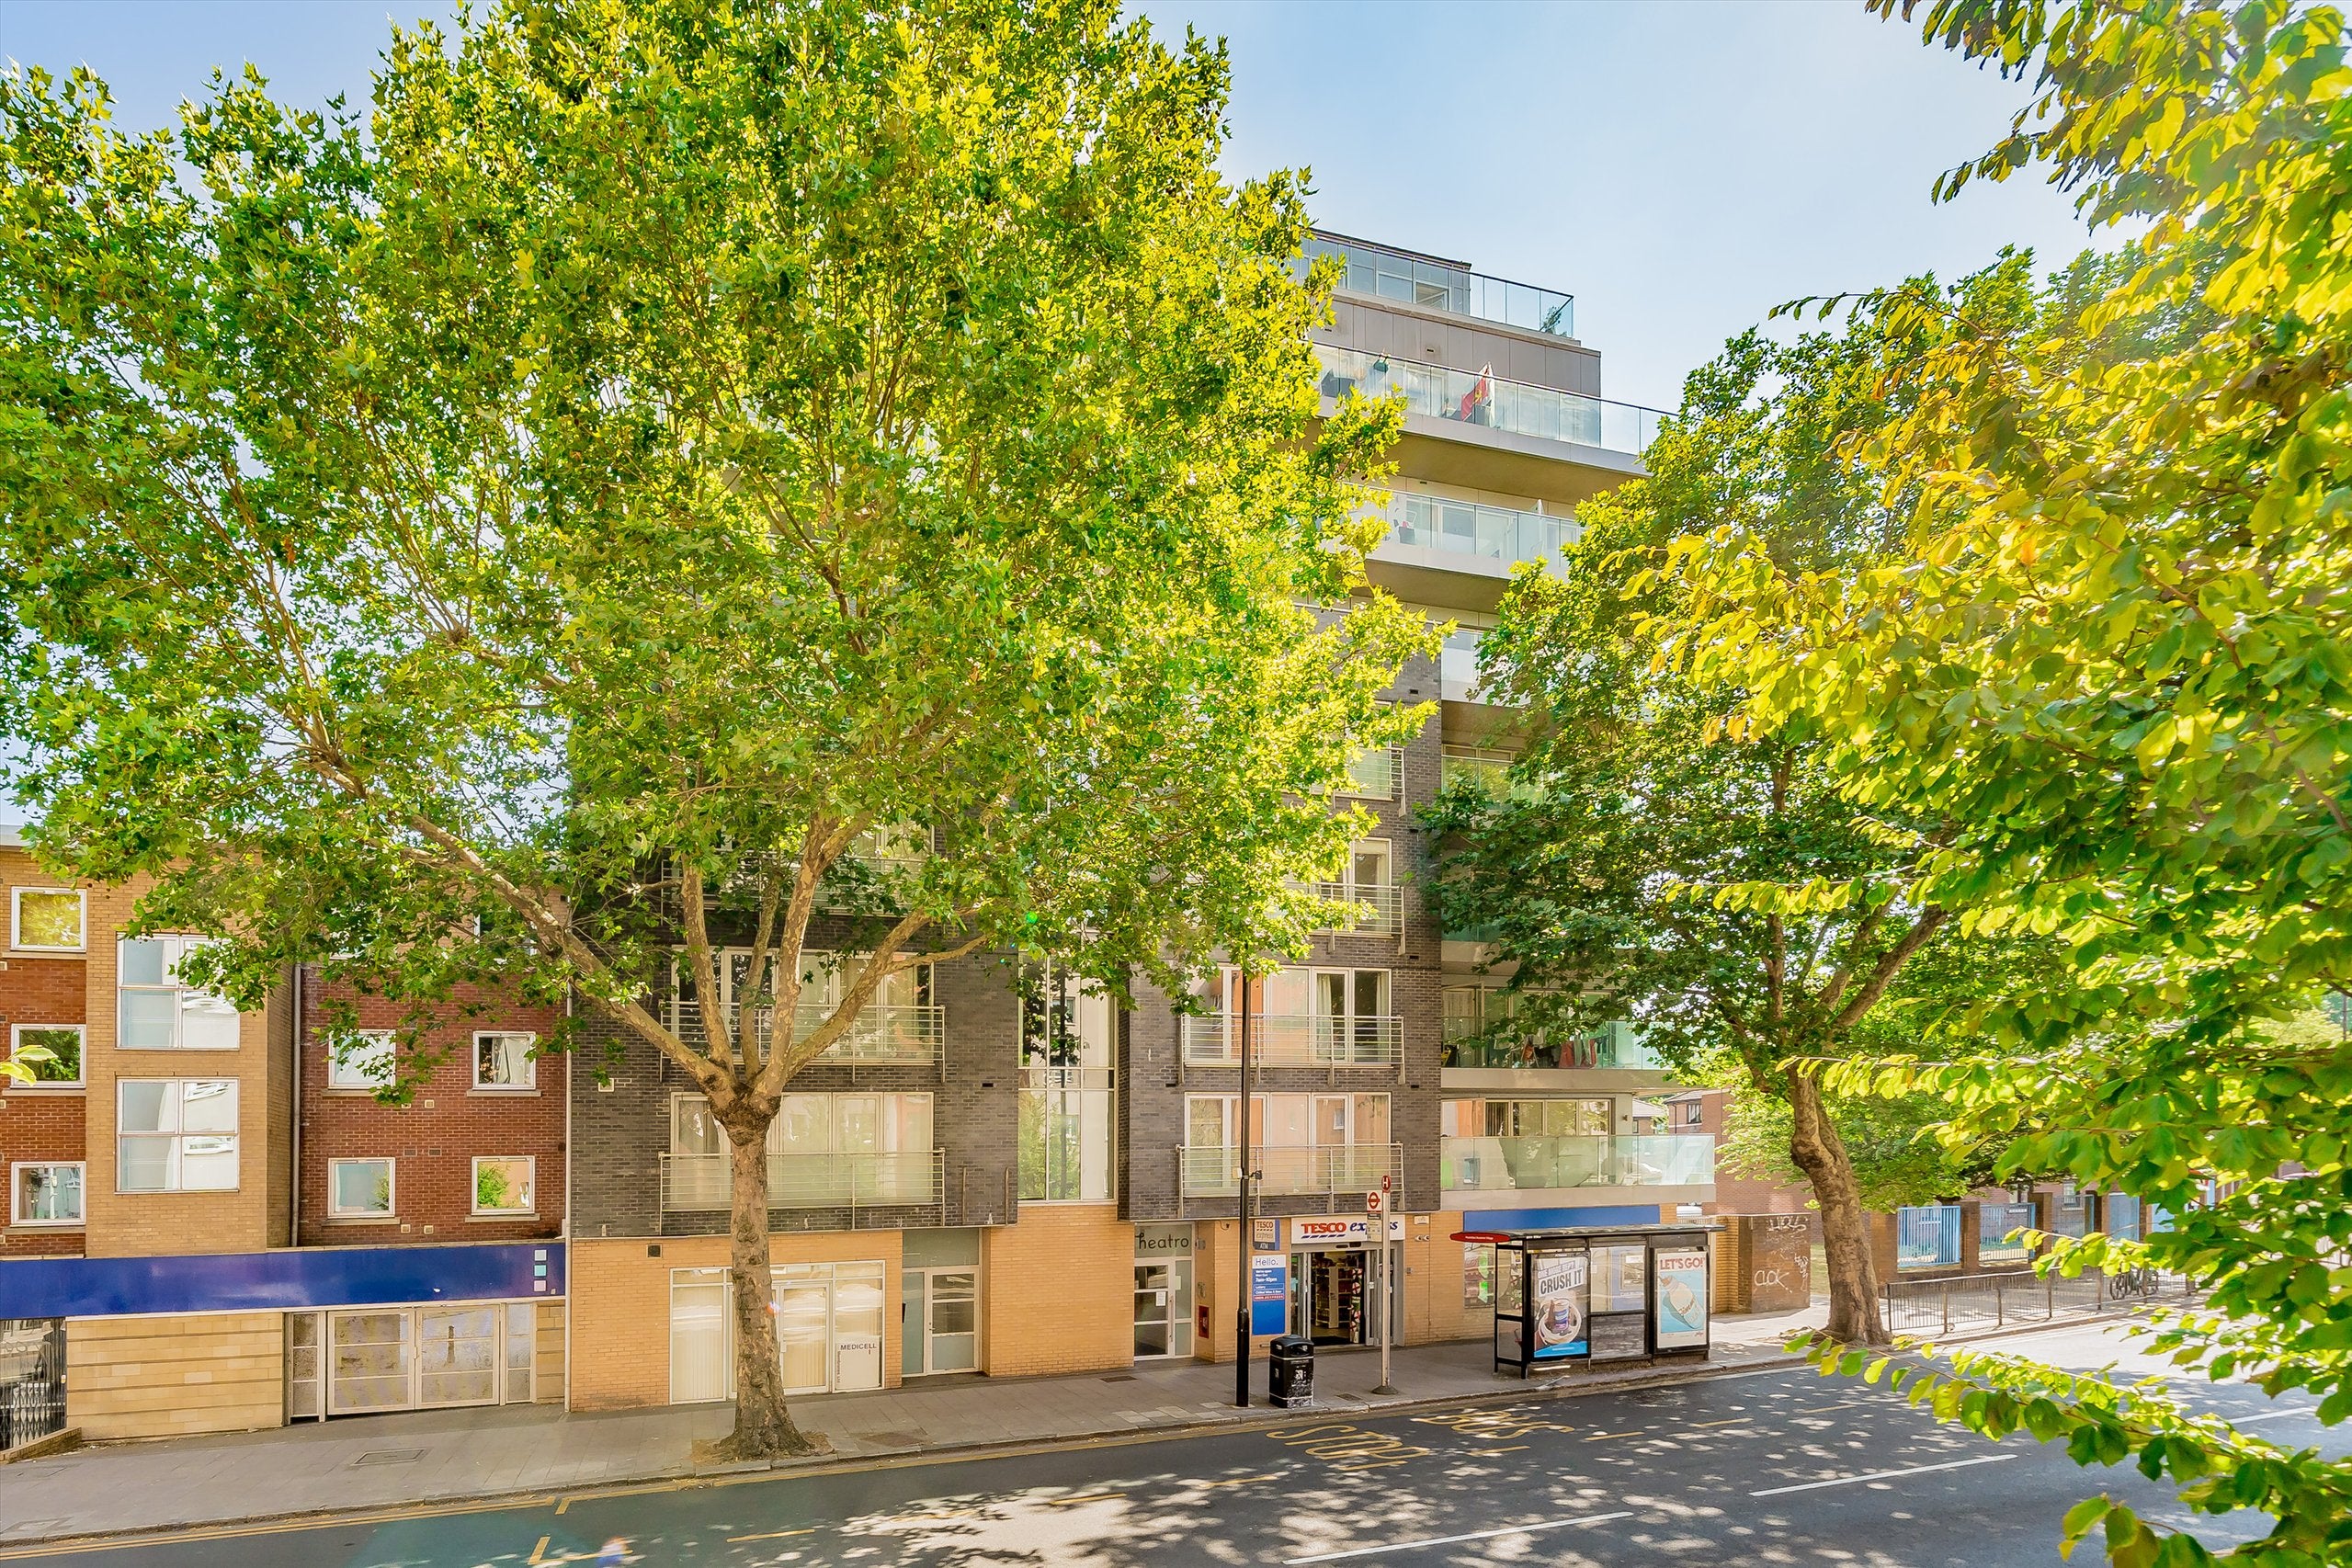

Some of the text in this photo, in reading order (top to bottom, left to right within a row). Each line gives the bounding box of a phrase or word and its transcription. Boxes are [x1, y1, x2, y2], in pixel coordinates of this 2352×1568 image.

[1382, 1177, 1389, 1188] H
[1301, 1222, 1346, 1233] TESCO
[1660, 1258, 1683, 1269] LET'S
[1540, 1268, 1582, 1294] CRUSH IT
[1267, 1426, 1430, 1460] STOP
